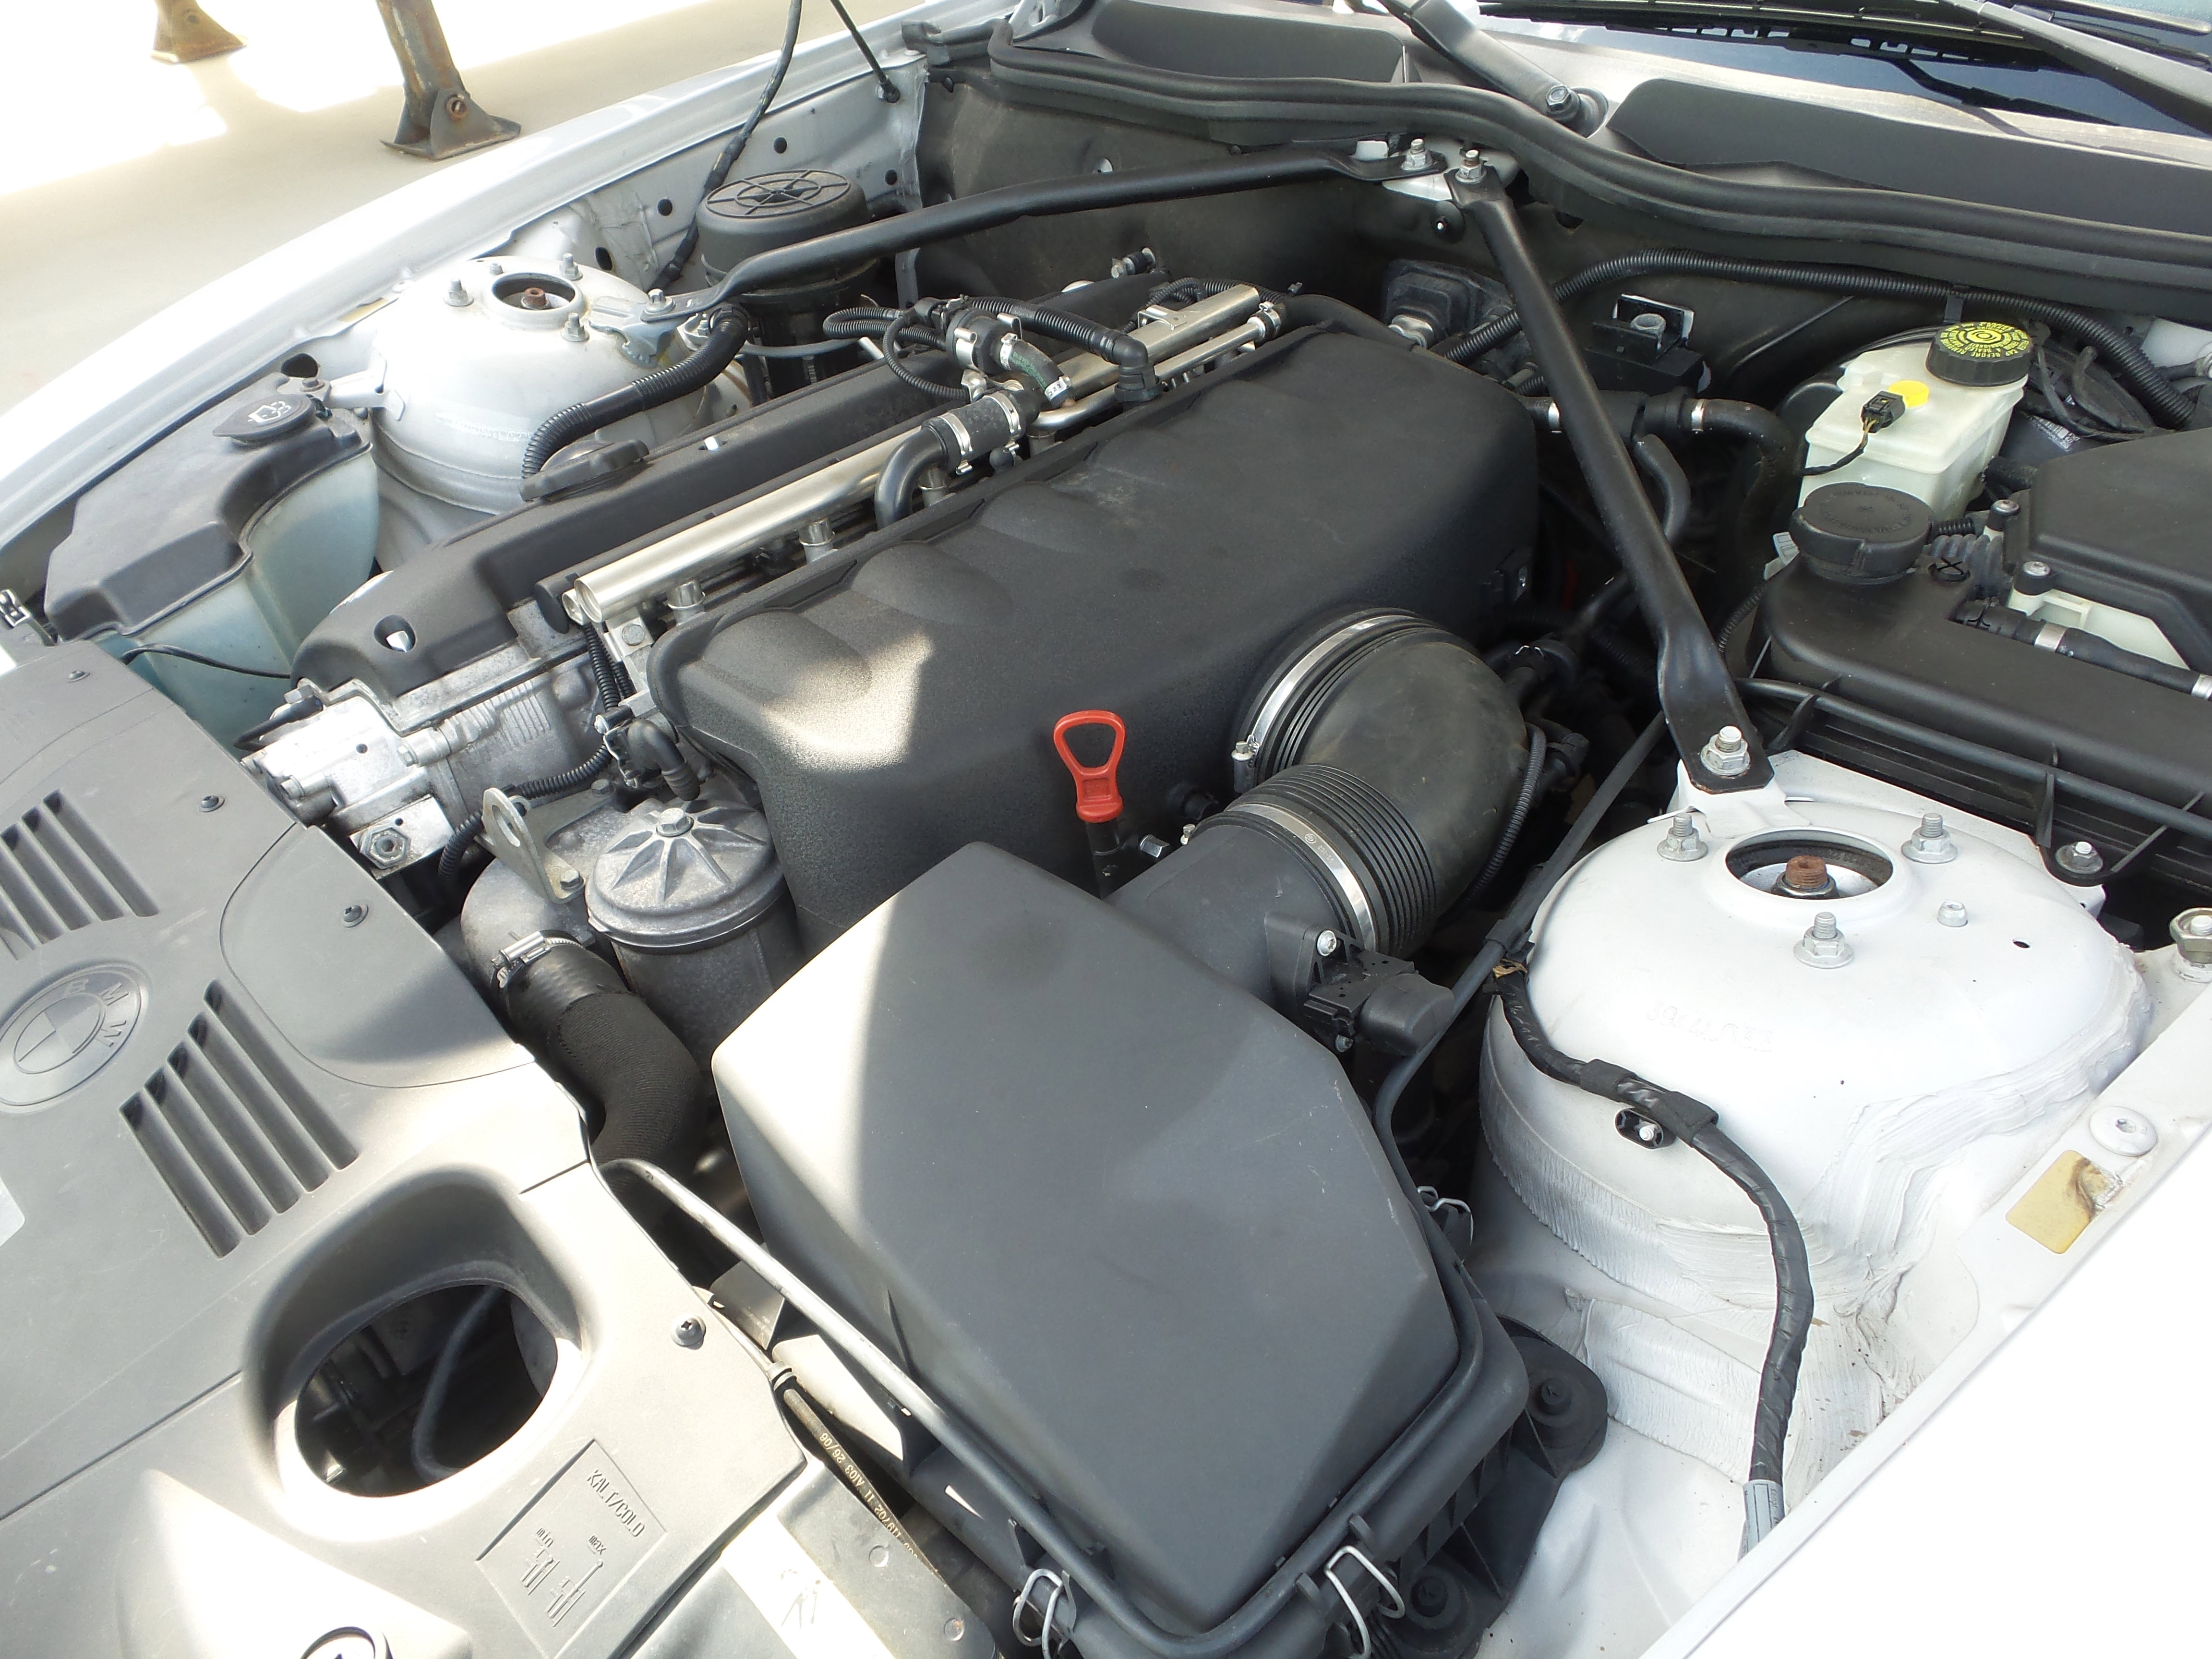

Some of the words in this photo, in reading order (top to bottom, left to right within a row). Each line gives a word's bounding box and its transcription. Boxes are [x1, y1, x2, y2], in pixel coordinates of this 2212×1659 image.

[819, 1432, 846, 1464] 26/06
[586, 1469, 645, 1538] KALT/COLD
[536, 1527, 554, 1548] min
[588, 1534, 607, 1555] max
